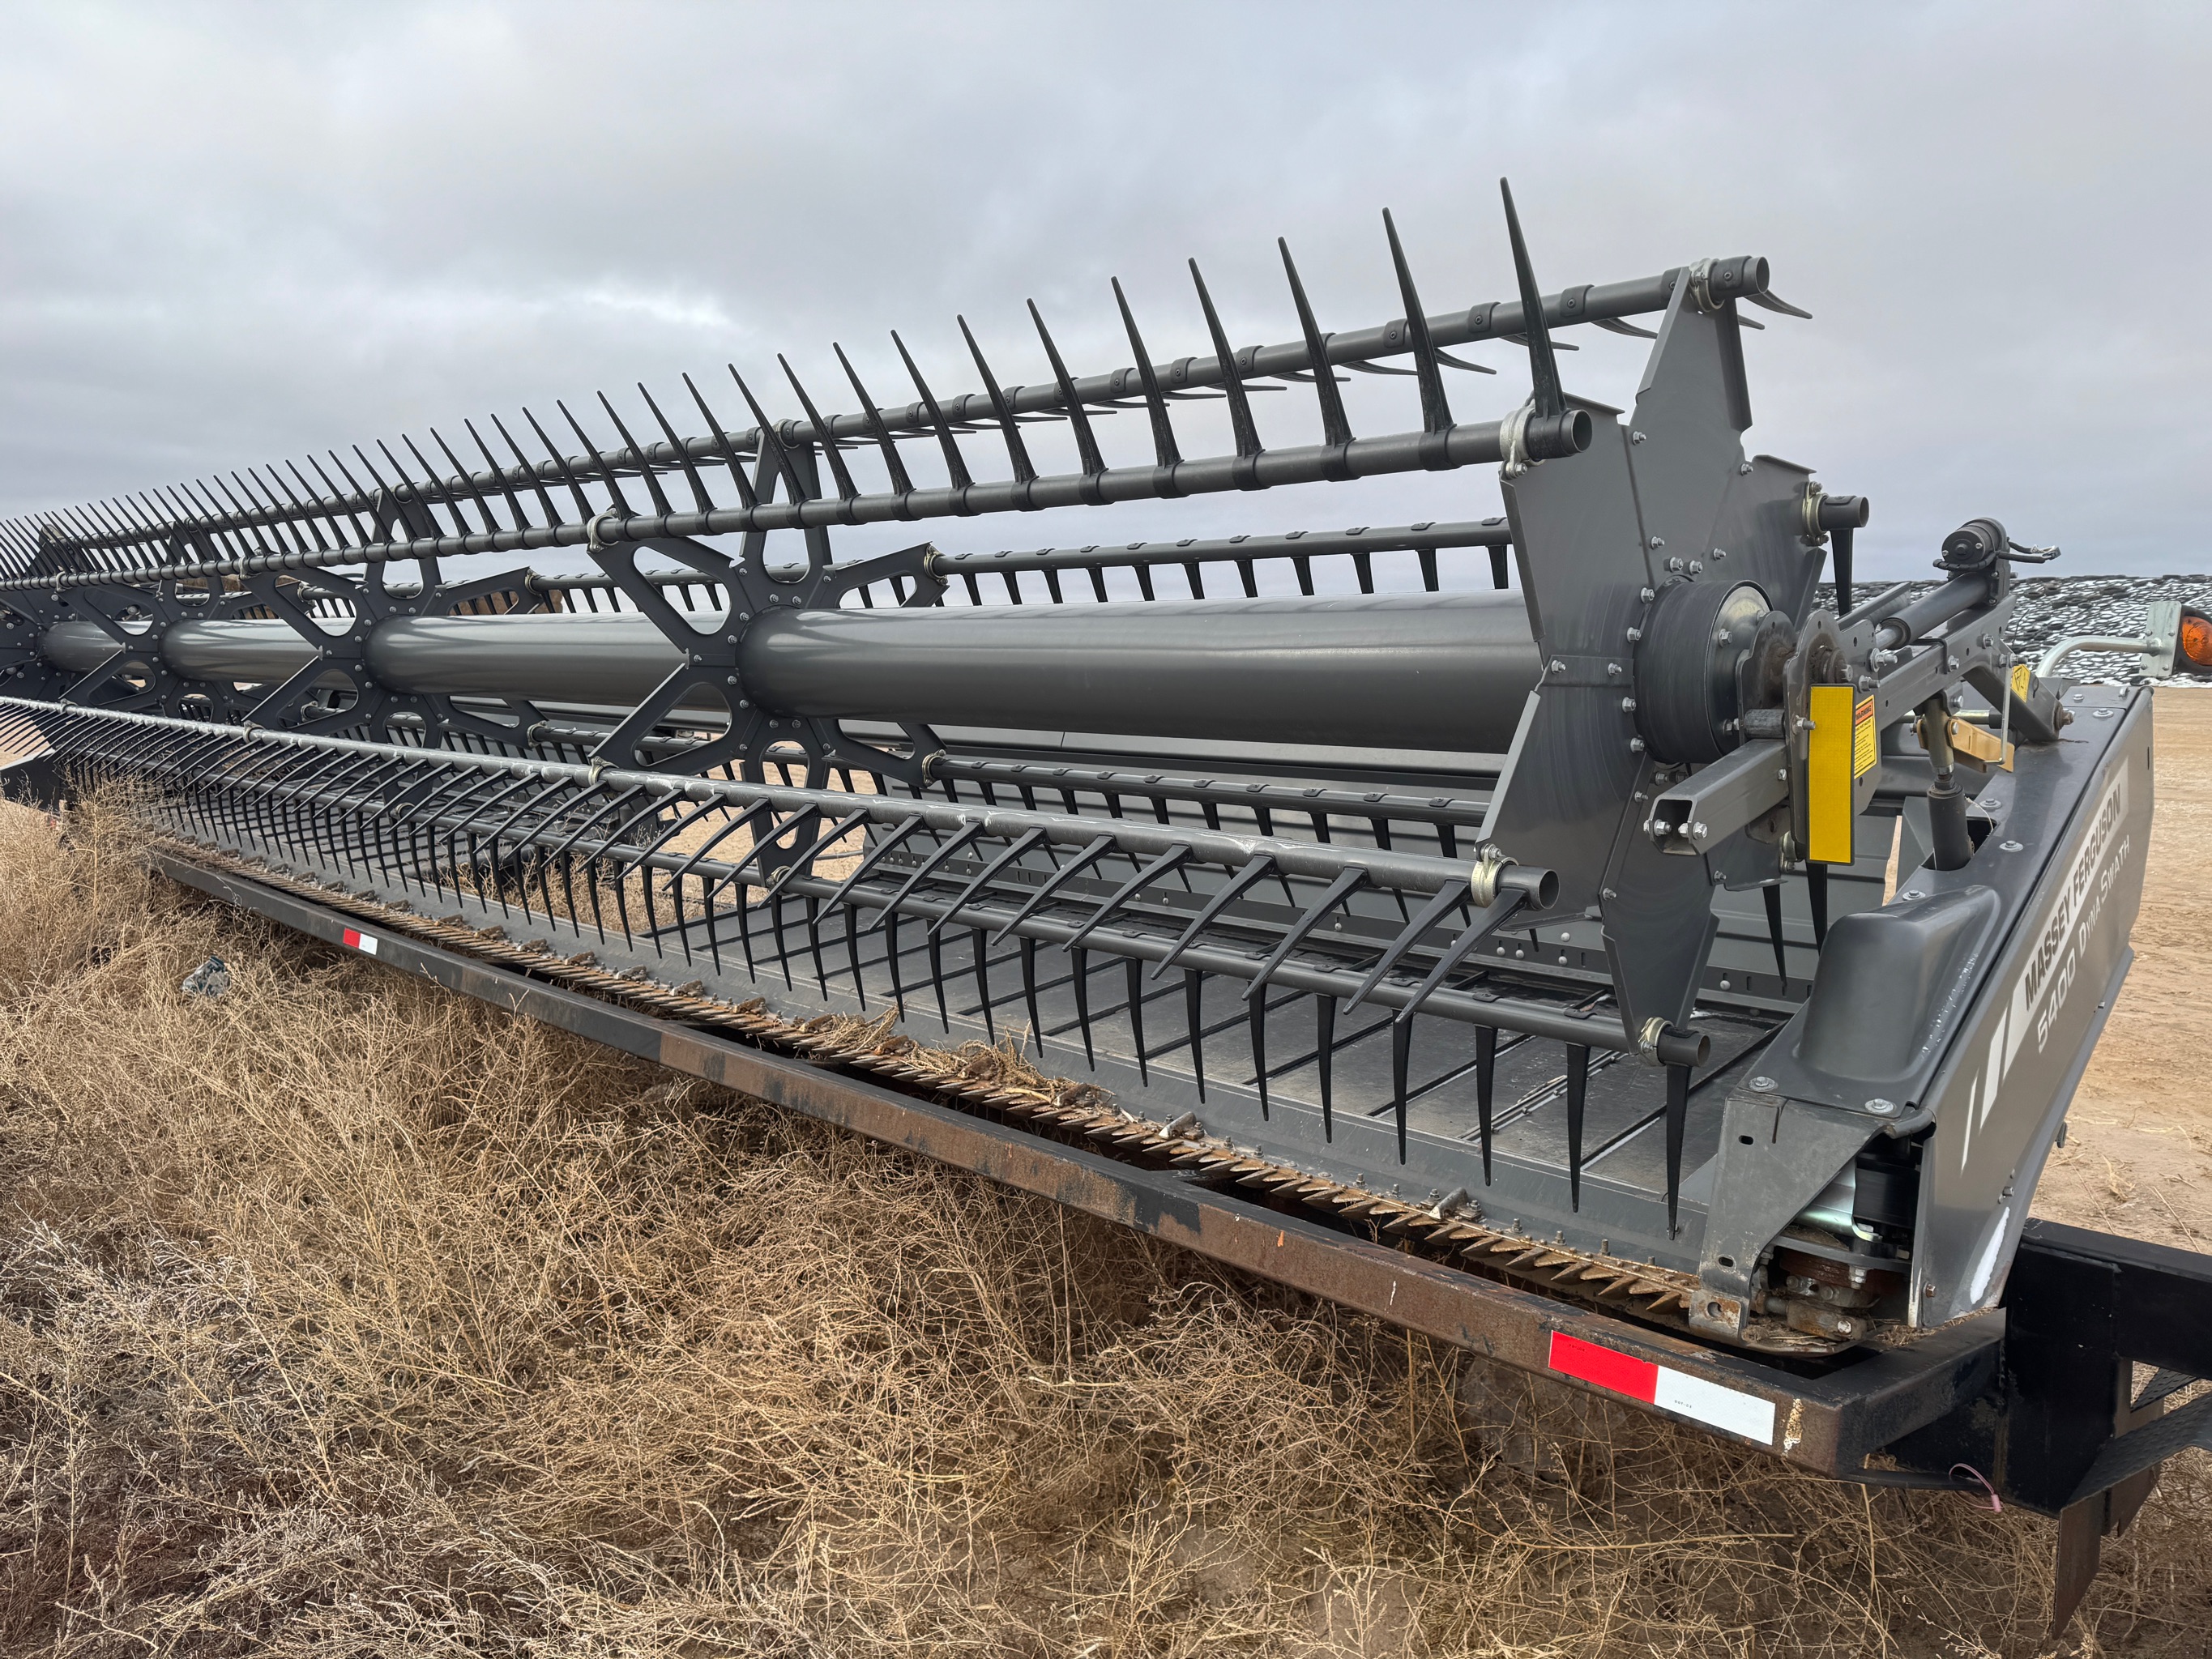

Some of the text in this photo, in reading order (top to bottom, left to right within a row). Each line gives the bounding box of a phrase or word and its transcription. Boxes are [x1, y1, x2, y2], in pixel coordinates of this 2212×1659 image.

[2025, 783, 2120, 1012] MASSEY FERGUSON
[2038, 947, 2076, 1054] 5400
